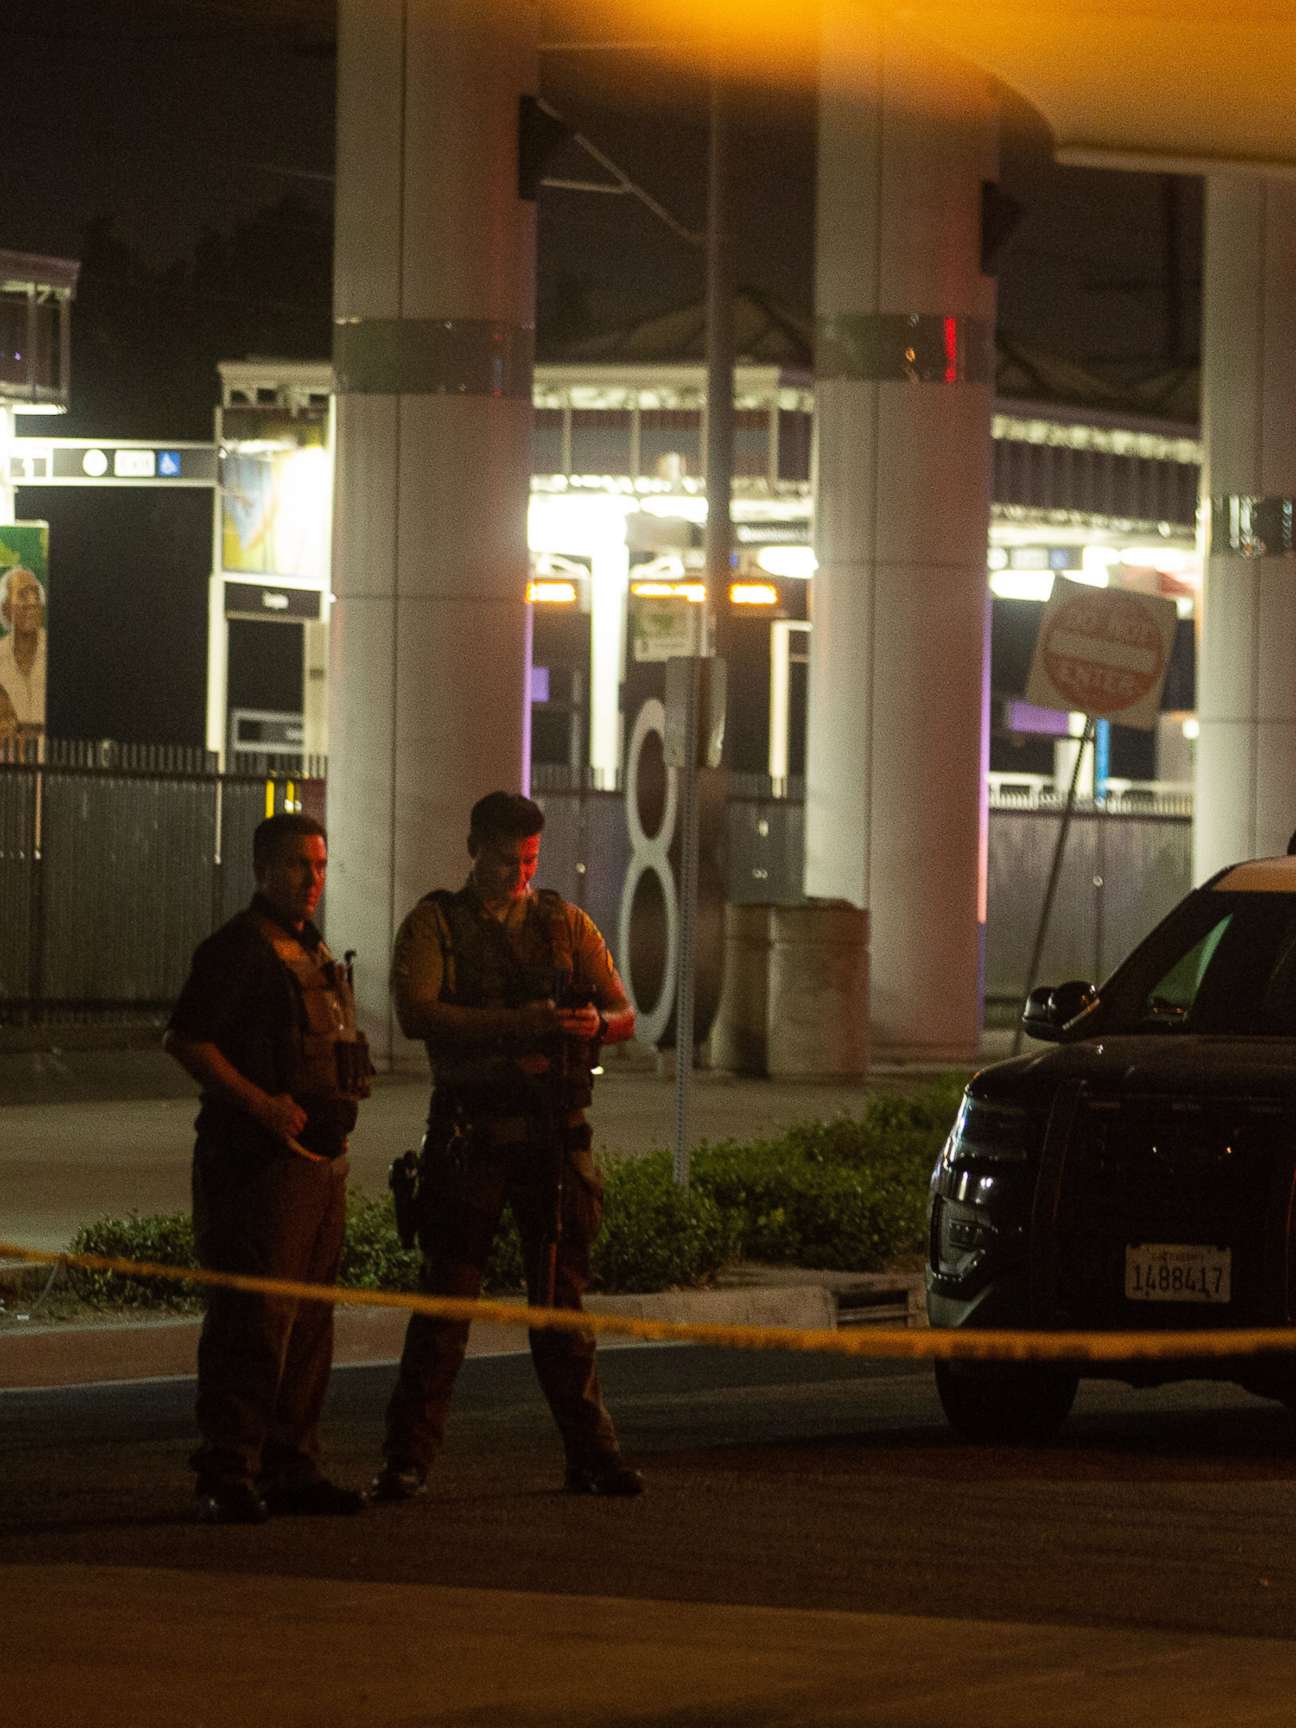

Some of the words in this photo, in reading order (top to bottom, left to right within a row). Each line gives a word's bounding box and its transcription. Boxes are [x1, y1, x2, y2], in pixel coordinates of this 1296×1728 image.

[1065, 604, 1097, 632] DO
[1108, 611, 1153, 643] NOT
[1058, 660, 1136, 696] ENTER
[1132, 1264, 1223, 1295] 1488417
